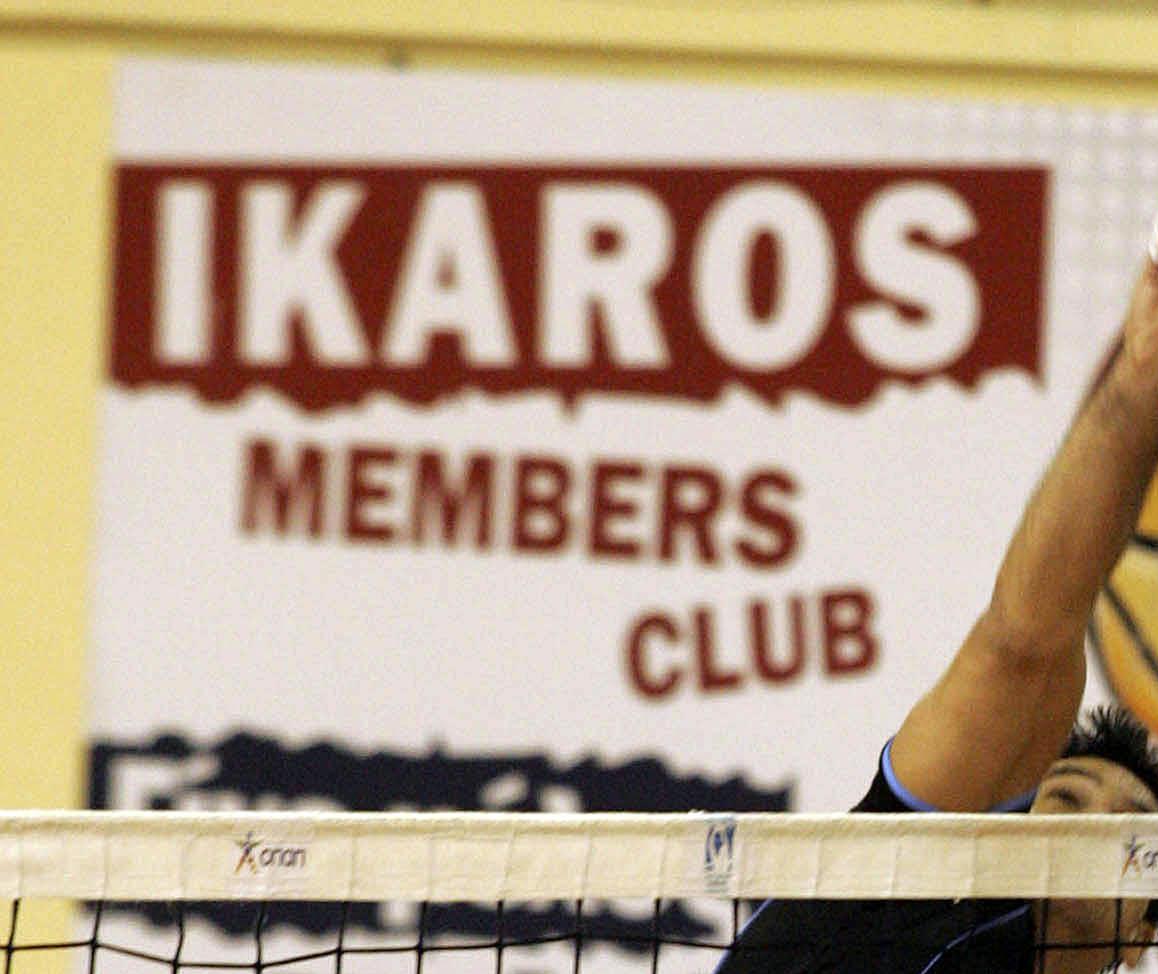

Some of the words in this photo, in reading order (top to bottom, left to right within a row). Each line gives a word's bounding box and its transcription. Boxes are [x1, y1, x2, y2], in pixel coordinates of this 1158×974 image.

[155, 180, 983, 373] IKAROS
[239, 438, 802, 570] MEMBERS
[623, 587, 880, 701] CLUB
